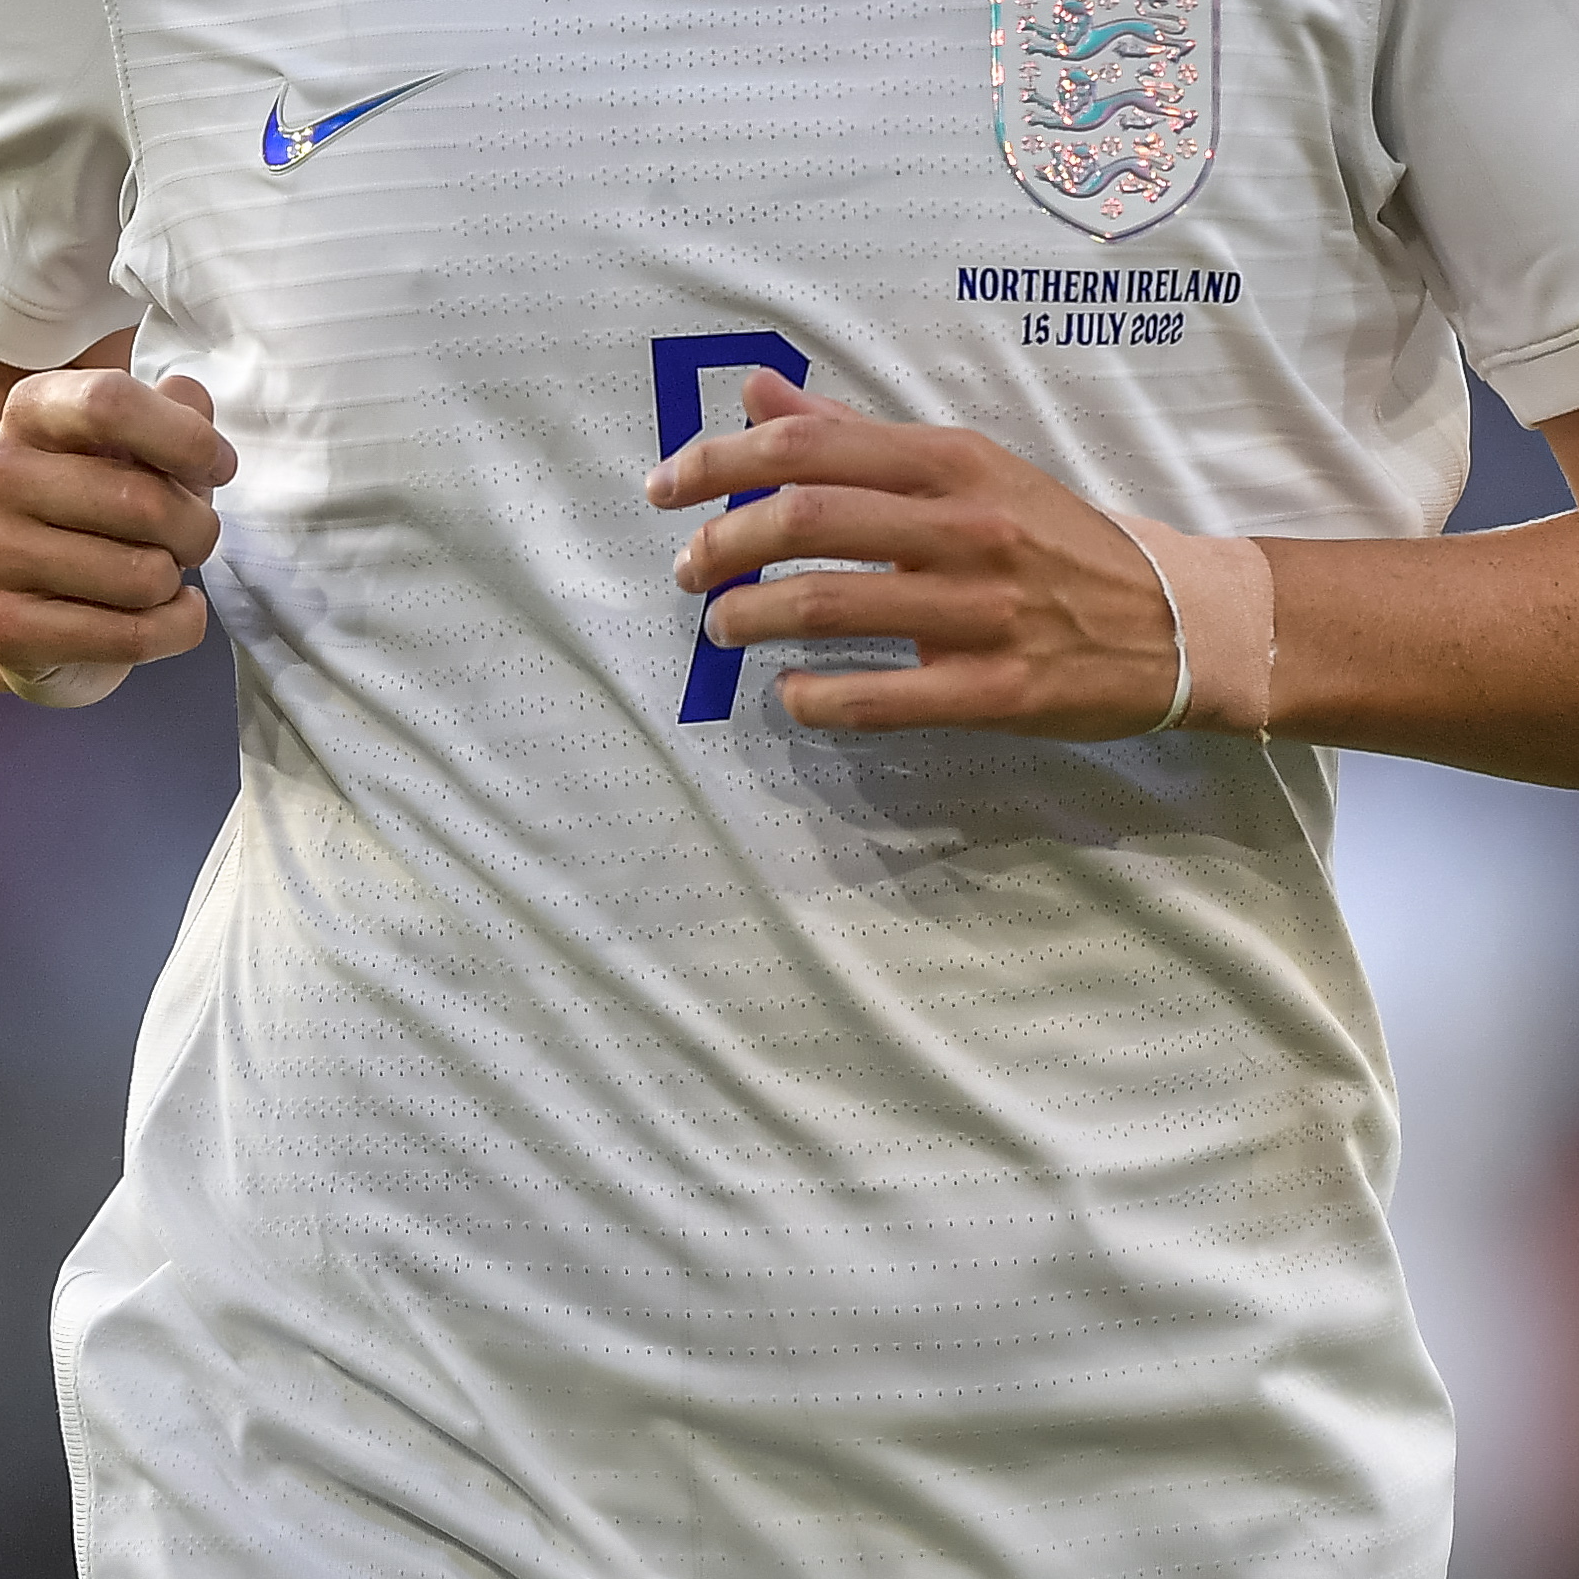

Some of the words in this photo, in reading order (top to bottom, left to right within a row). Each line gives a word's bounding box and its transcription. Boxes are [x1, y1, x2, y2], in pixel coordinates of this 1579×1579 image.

[957, 267, 1120, 304] NORTHERN
[1126, 269, 1242, 304] IRELAND
[1021, 312, 1051, 346] 15
[1055, 312, 1128, 346] JULY
[1130, 311, 1185, 346] 2022
